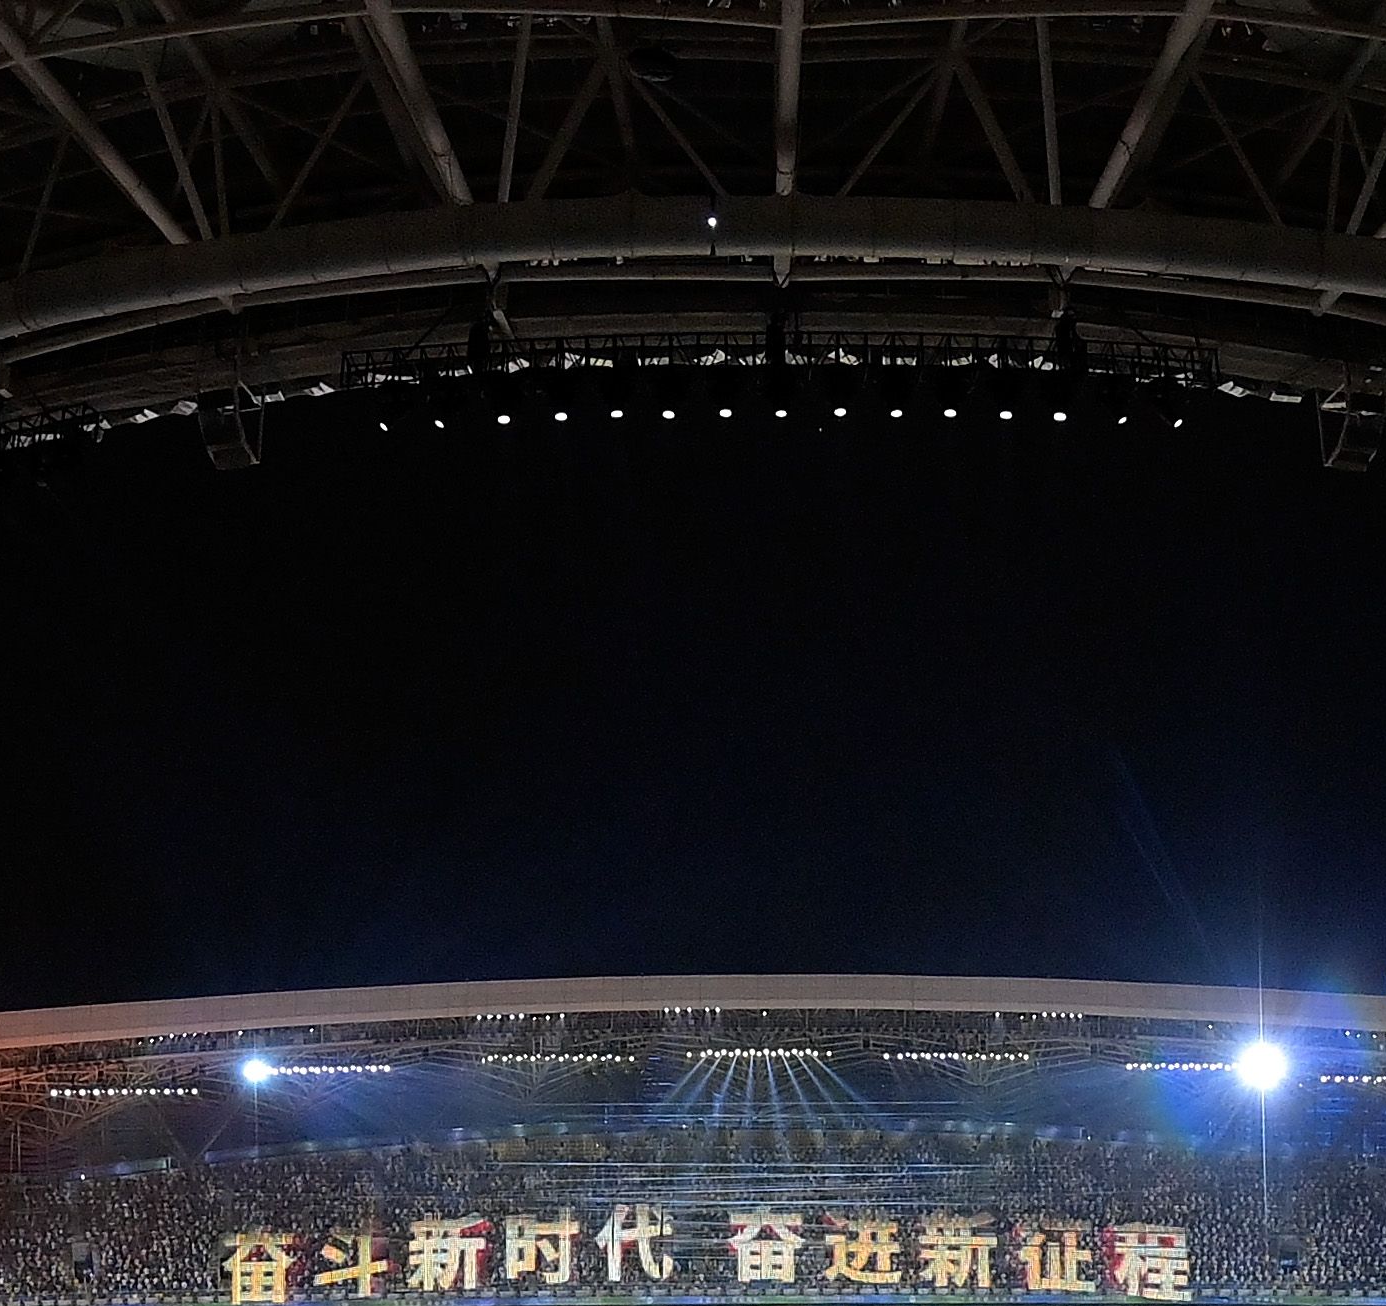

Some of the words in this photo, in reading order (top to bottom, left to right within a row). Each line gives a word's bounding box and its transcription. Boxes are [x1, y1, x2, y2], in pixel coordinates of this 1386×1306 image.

[221, 1204, 674, 1304] 奋斗新时代
[728, 1208, 1191, 1301] 奋进新征程
